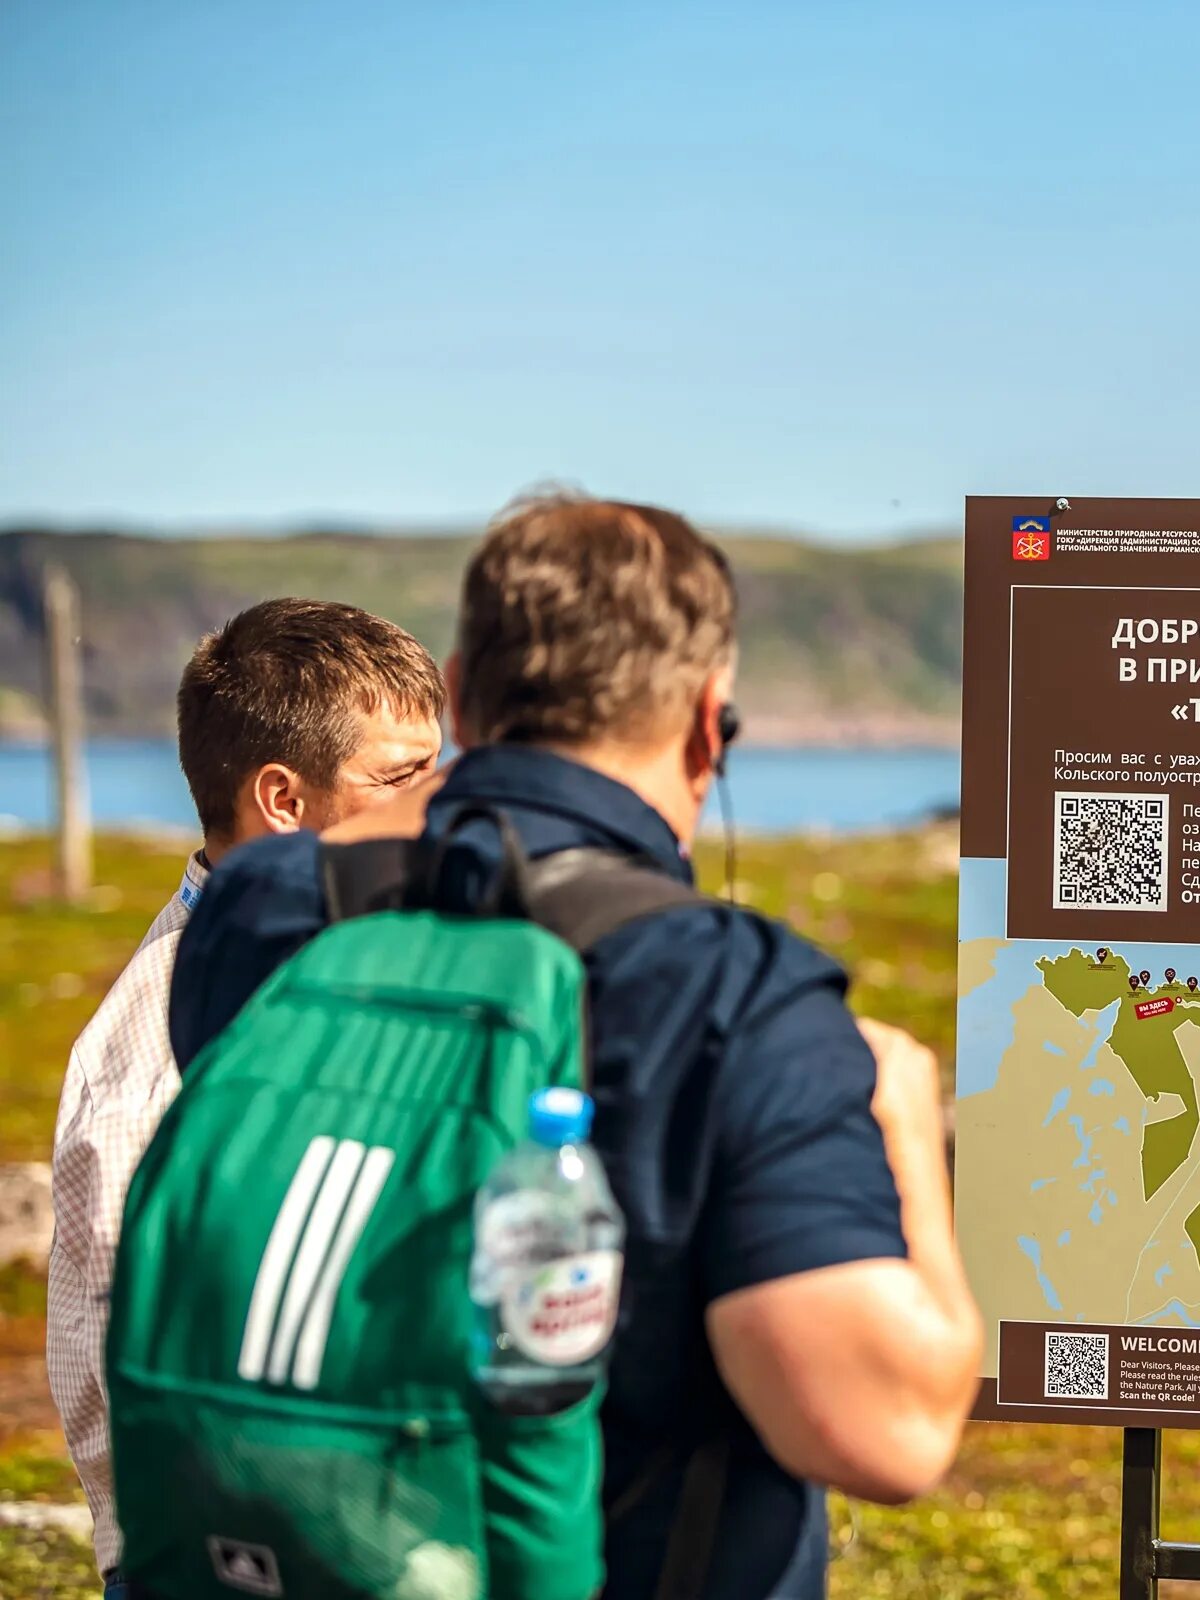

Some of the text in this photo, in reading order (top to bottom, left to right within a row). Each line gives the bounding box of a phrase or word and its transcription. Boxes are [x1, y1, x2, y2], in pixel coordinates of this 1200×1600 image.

[1056, 529, 1113, 537] МИНИСТЕРСТВО
[1115, 530, 1160, 539] ПРИРОДНЫХ
[1162, 530, 1199, 539] РЕСУРСОВ,
[1120, 538, 1190, 546] (АДМИНИСТРАЦИЯ)
[1119, 658, 1137, 682] В
[1054, 750, 1112, 766] Просим
[1121, 754, 1145, 765] вас
[1154, 754, 1161, 765] с
[1054, 767, 1130, 781] Кольского
[1120, 1360, 1139, 1369] Dear
[1141, 1361, 1173, 1371] Visitors,
[1175, 1362, 1200, 1371] Please
[1120, 1371, 1146, 1379] Please
[1148, 1372, 1166, 1380] read
[1120, 1381, 1133, 1389] the
[1135, 1382, 1162, 1390] Nature
[1165, 1383, 1184, 1391] Park.
[1142, 1392, 1156, 1400] the
[1158, 1393, 1170, 1402] QR
[1172, 1394, 1194, 1402] code!
